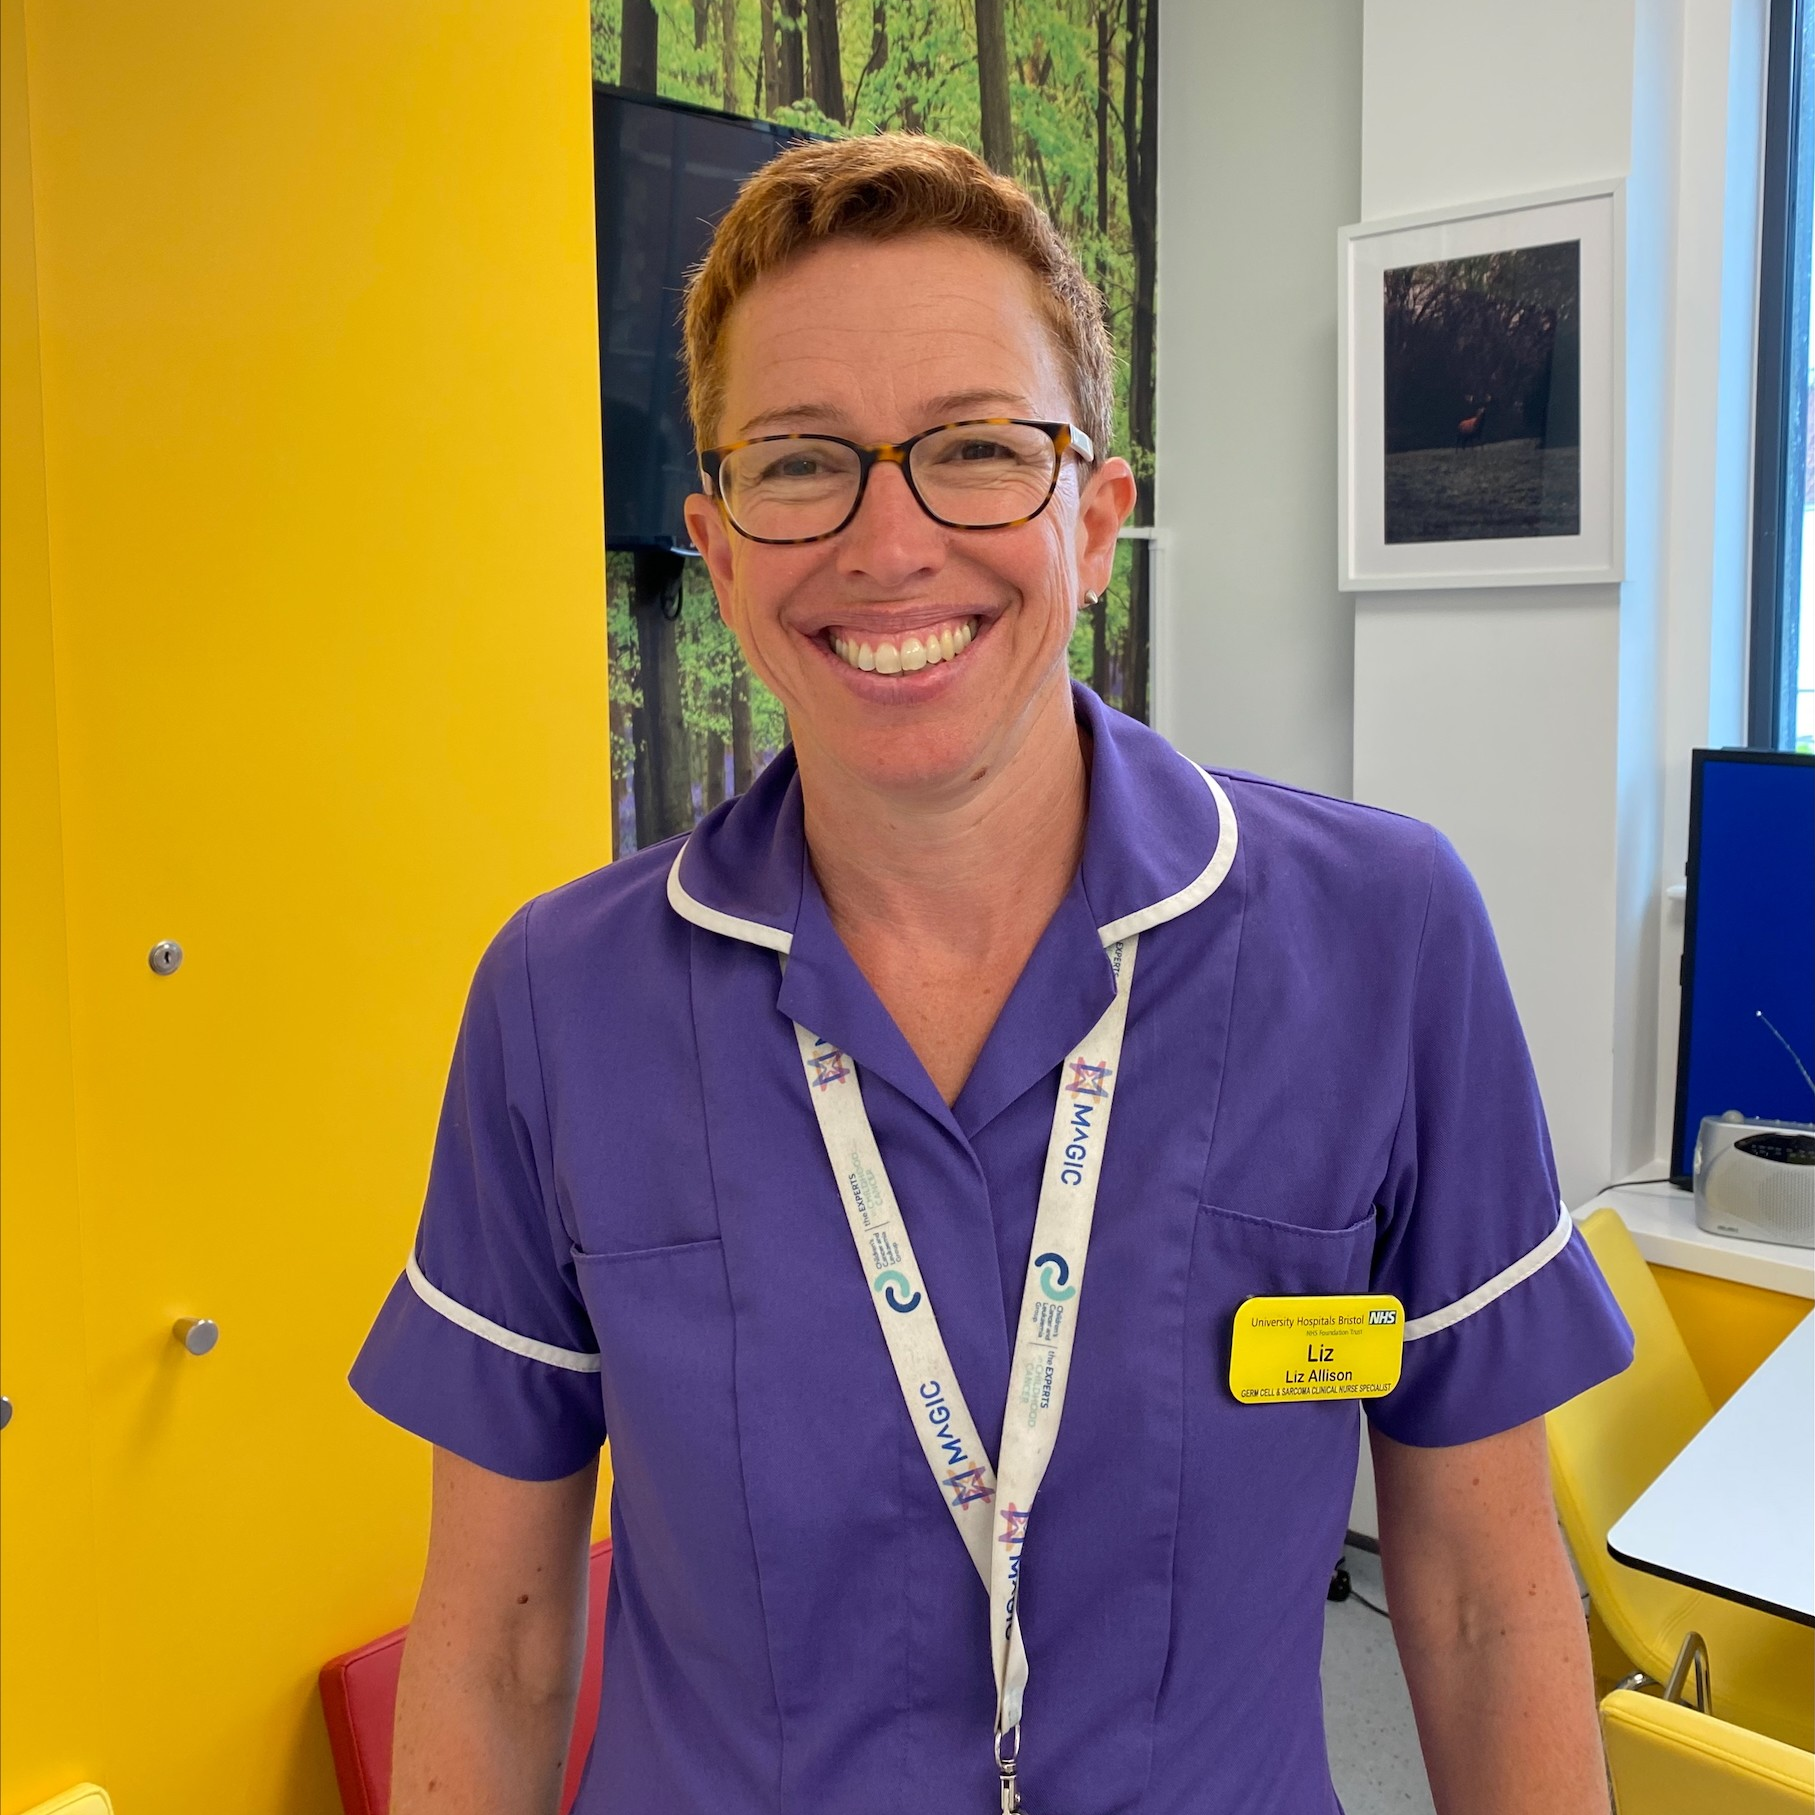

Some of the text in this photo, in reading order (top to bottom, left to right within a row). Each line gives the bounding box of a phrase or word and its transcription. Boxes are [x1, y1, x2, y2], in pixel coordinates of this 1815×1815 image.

[1060, 1103, 1094, 1186] MAGIC
[849, 1173, 871, 1227] the EXPERTS
[1251, 1315, 1364, 1329] University Hospitals Bristol
[1369, 1311, 1396, 1325] NHS
[1046, 1350, 1055, 1366] the
[1308, 1344, 1334, 1362] Liz
[1022, 1362, 1034, 1404] CANCER
[1040, 1366, 1054, 1409] EXPERTS
[1241, 1383, 1392, 1398] GERM CELL & SARCOMA CLINICAL NURSE SPECIALIST
[1285, 1369, 1352, 1384] Liz Allison
[1028, 1364, 1044, 1428] CHILDHOOD
[920, 1381, 968, 1465] MAGIC
